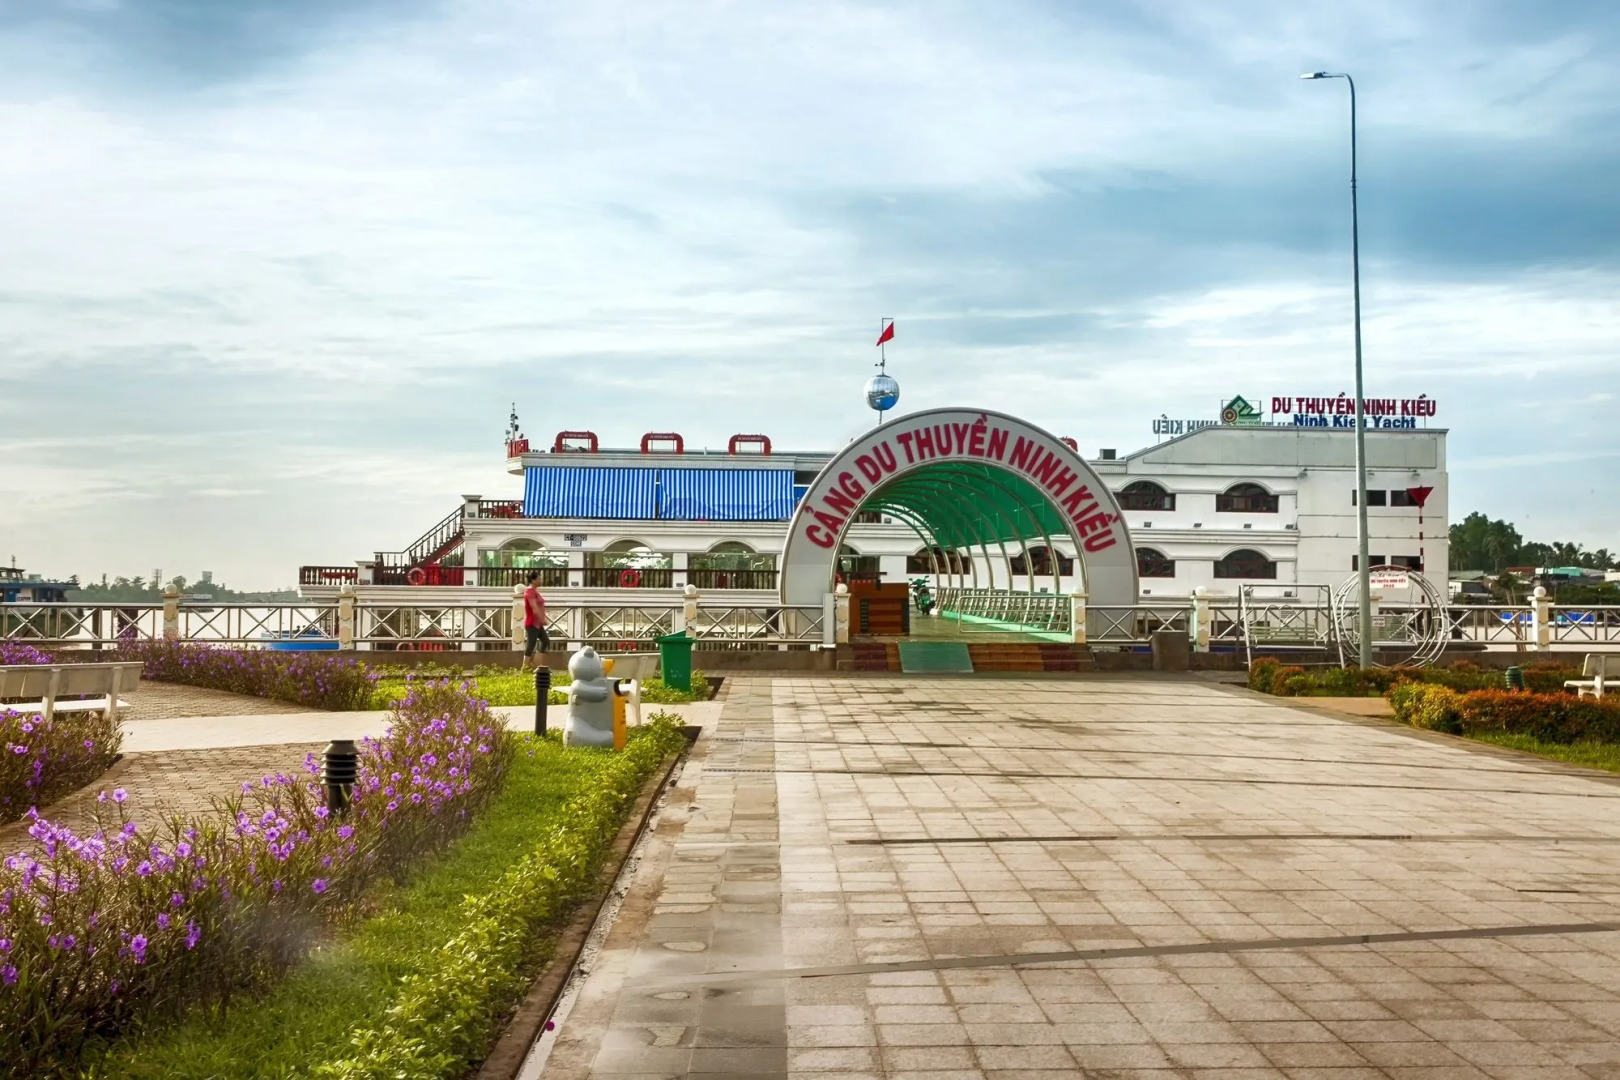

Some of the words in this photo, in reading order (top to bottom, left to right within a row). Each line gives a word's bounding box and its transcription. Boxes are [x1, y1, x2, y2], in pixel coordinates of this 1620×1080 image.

[1272, 397, 1292, 414] DU
[1362, 399, 1396, 416] NINH
[1293, 414, 1328, 428] Ninh
[1372, 415, 1416, 429] Yacht
[805, 473, 864, 548] CẢNG
[855, 441, 897, 483] DU
[896, 413, 1009, 463] THUYỀN
[1009, 437, 1077, 498] NINH
[1063, 486, 1119, 552] KIỀU
